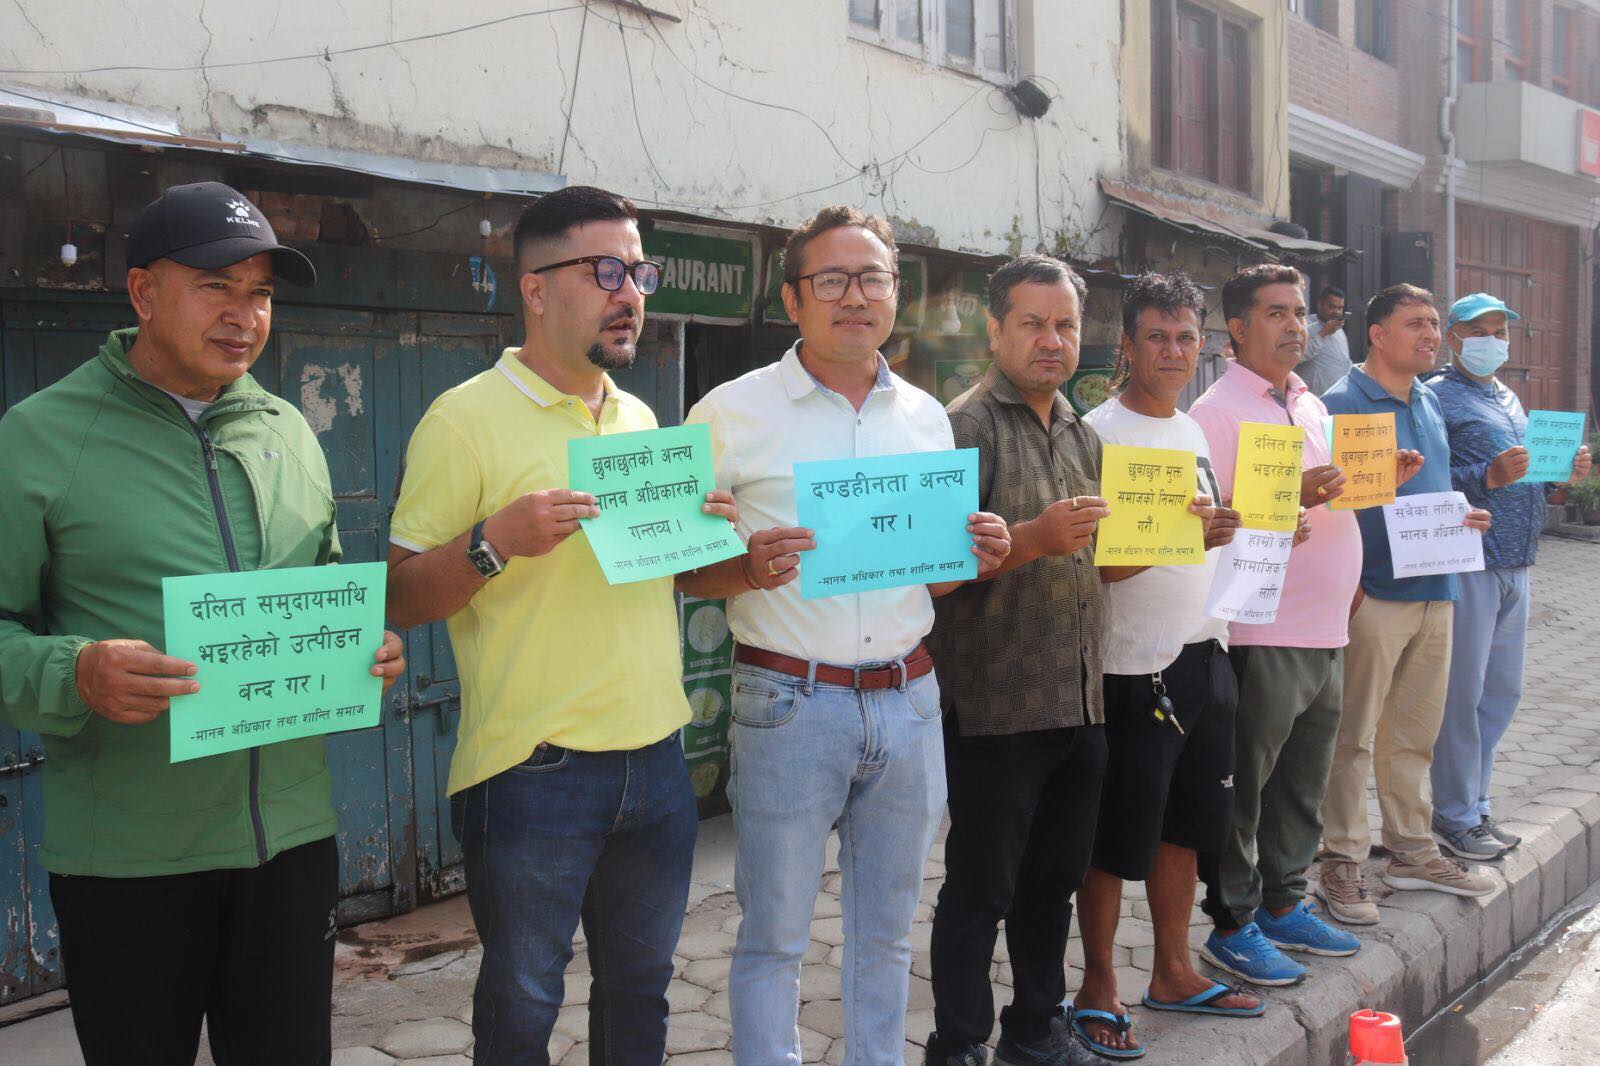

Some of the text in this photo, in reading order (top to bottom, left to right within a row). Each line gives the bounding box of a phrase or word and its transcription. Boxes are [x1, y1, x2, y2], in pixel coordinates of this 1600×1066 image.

[644, 253, 745, 295] TAURANT
[1254, 433, 1287, 451] दलित
[592, 445, 654, 480] छुवाछुतको
[1128, 462, 1183, 483] छुवाछुत मुक्त
[1252, 462, 1296, 478] भइरहेको
[635, 475, 700, 504] अधिकारको
[810, 471, 908, 499] दण्डहीनता
[1117, 488, 1188, 507] समाजको निर्माण
[1274, 490, 1292, 503] बन्द
[1433, 499, 1455, 516] लागि
[628, 519, 673, 541] गन्तव्य
[870, 514, 898, 533] गर
[1400, 528, 1429, 541] मानव
[1433, 523, 1465, 538] अधिकार
[706, 538, 729, 553] समाज
[818, 560, 965, 586] -मानव अधिकार तथा शान्ति समाज
[1232, 557, 1282, 574] सामाजिक
[190, 581, 368, 621] दलित समुदायमाथि
[198, 625, 363, 665] भइरहेको उत्पीडन
[238, 679, 275, 702] बन्द
[285, 675, 311, 695] गर
[190, 704, 366, 741] -मानव अधिकार तथा शान्ति समाज
